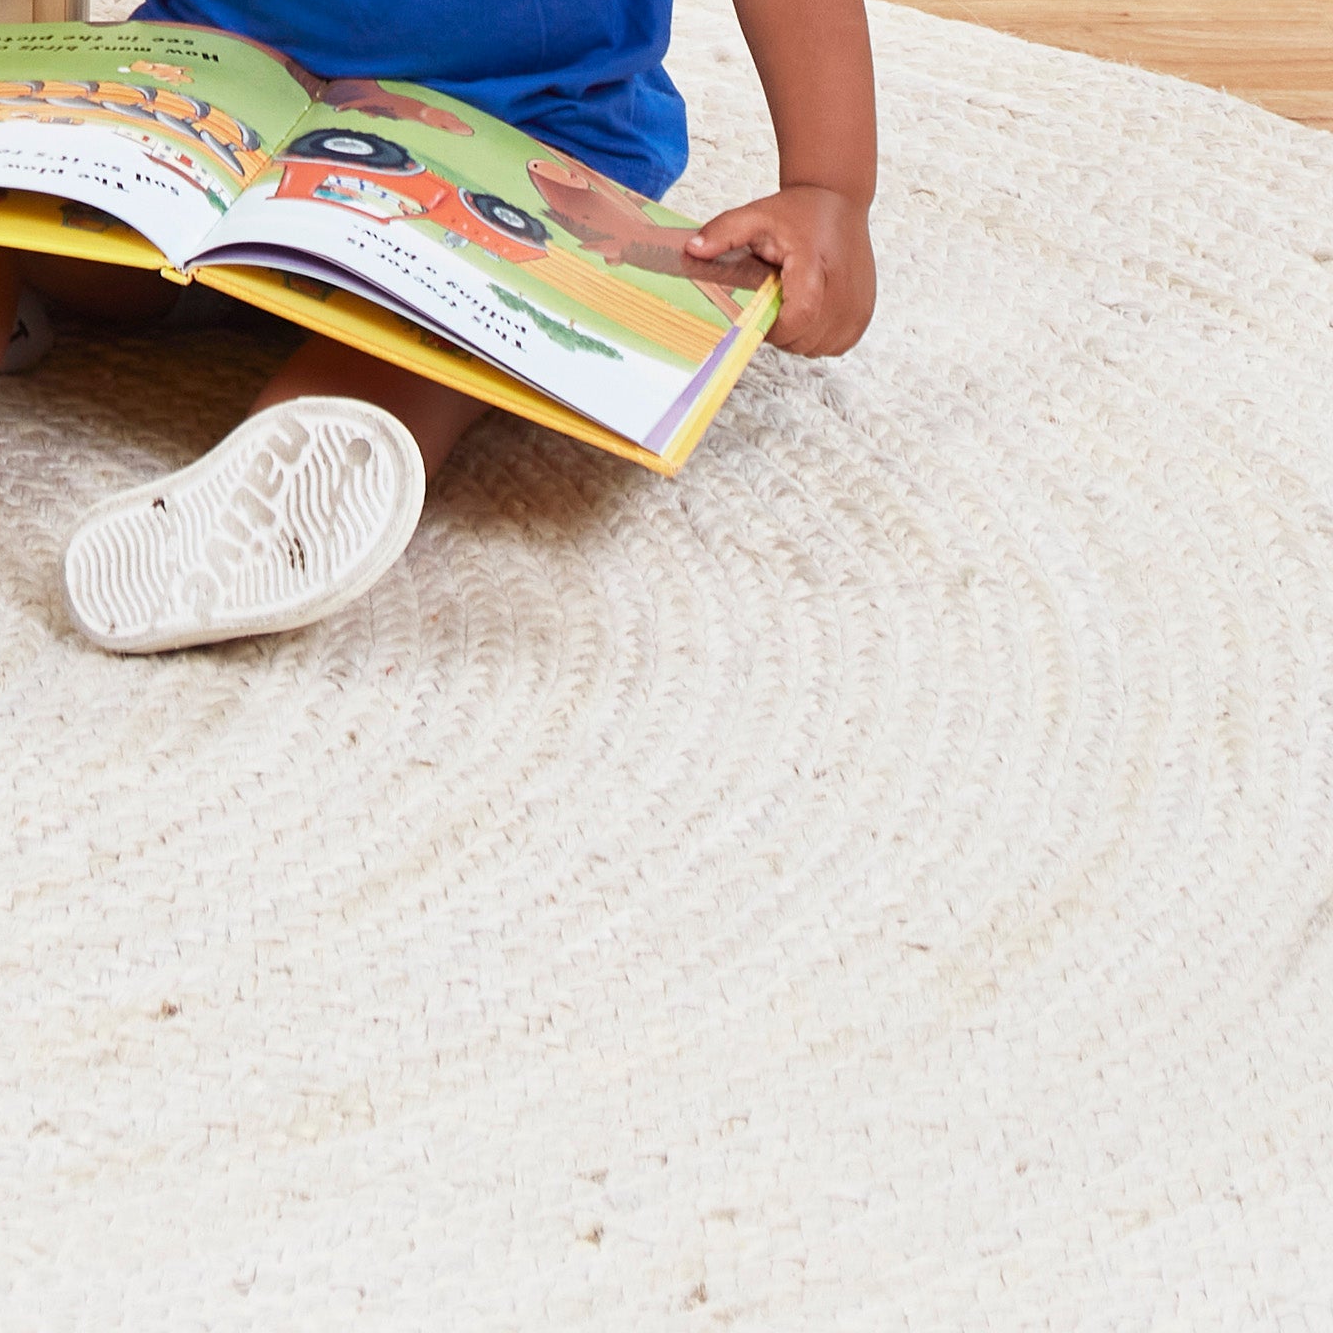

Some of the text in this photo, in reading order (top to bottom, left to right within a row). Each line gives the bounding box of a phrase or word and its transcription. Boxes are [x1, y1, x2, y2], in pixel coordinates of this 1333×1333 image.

[164, 47, 220, 63] How
[77, 173, 129, 194] The
[135, 172, 181, 197] soil
[473, 314, 528, 353] This
[182, 415, 311, 619] native
